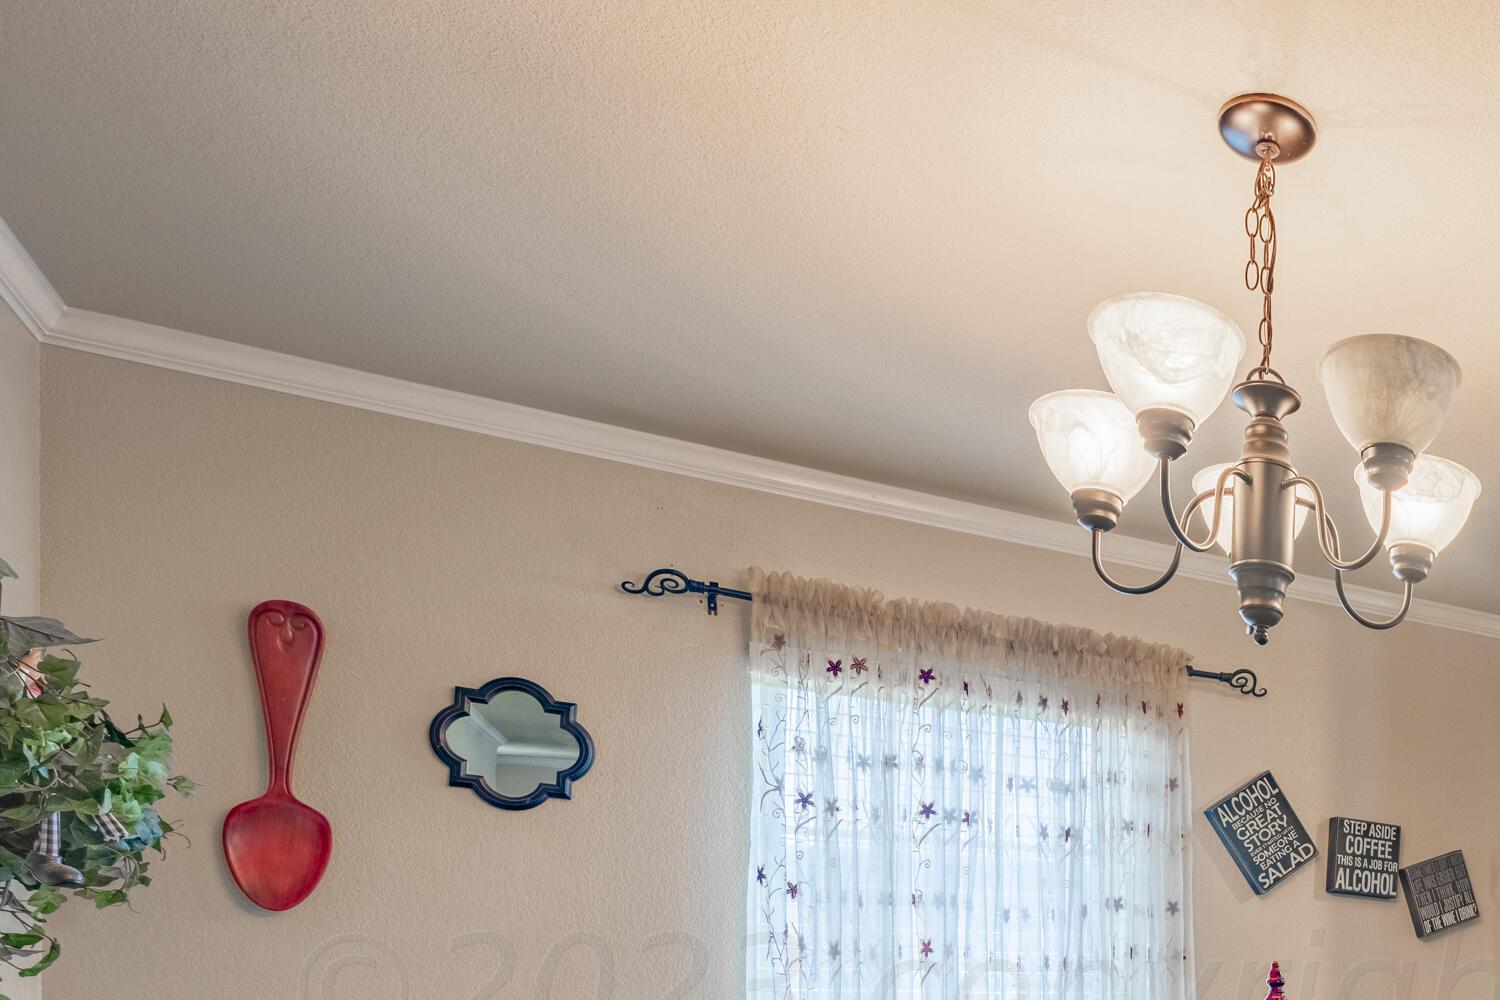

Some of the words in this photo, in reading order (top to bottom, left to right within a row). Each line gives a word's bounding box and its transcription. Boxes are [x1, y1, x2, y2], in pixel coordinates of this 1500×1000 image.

[1217, 777, 1279, 827] ALCOHOL
[1231, 806, 1264, 830] BECAUSE
[1264, 797, 1277, 808] NO
[1236, 803, 1283, 840] GREAT
[1243, 814, 1290, 853] STORY
[1343, 819, 1367, 836] STEP
[1368, 823, 1397, 841] ASIDE
[1252, 830, 1298, 865] SOMEONE
[1259, 845, 1293, 870] EATING
[1293, 840, 1301, 849] A
[1345, 835, 1393, 859] COFFEE
[1258, 843, 1315, 888] SALAD
[1337, 854, 1353, 867] THIS
[1354, 857, 1362, 867] IS
[1362, 858, 1368, 869] A
[1369, 859, 1382, 871] JOB
[1384, 861, 1398, 873] FOR
[1335, 867, 1397, 896] ALCOHOL
[1423, 919, 1432, 933] OF
[1431, 915, 1443, 930] THE
[1441, 911, 1457, 927] WINE
